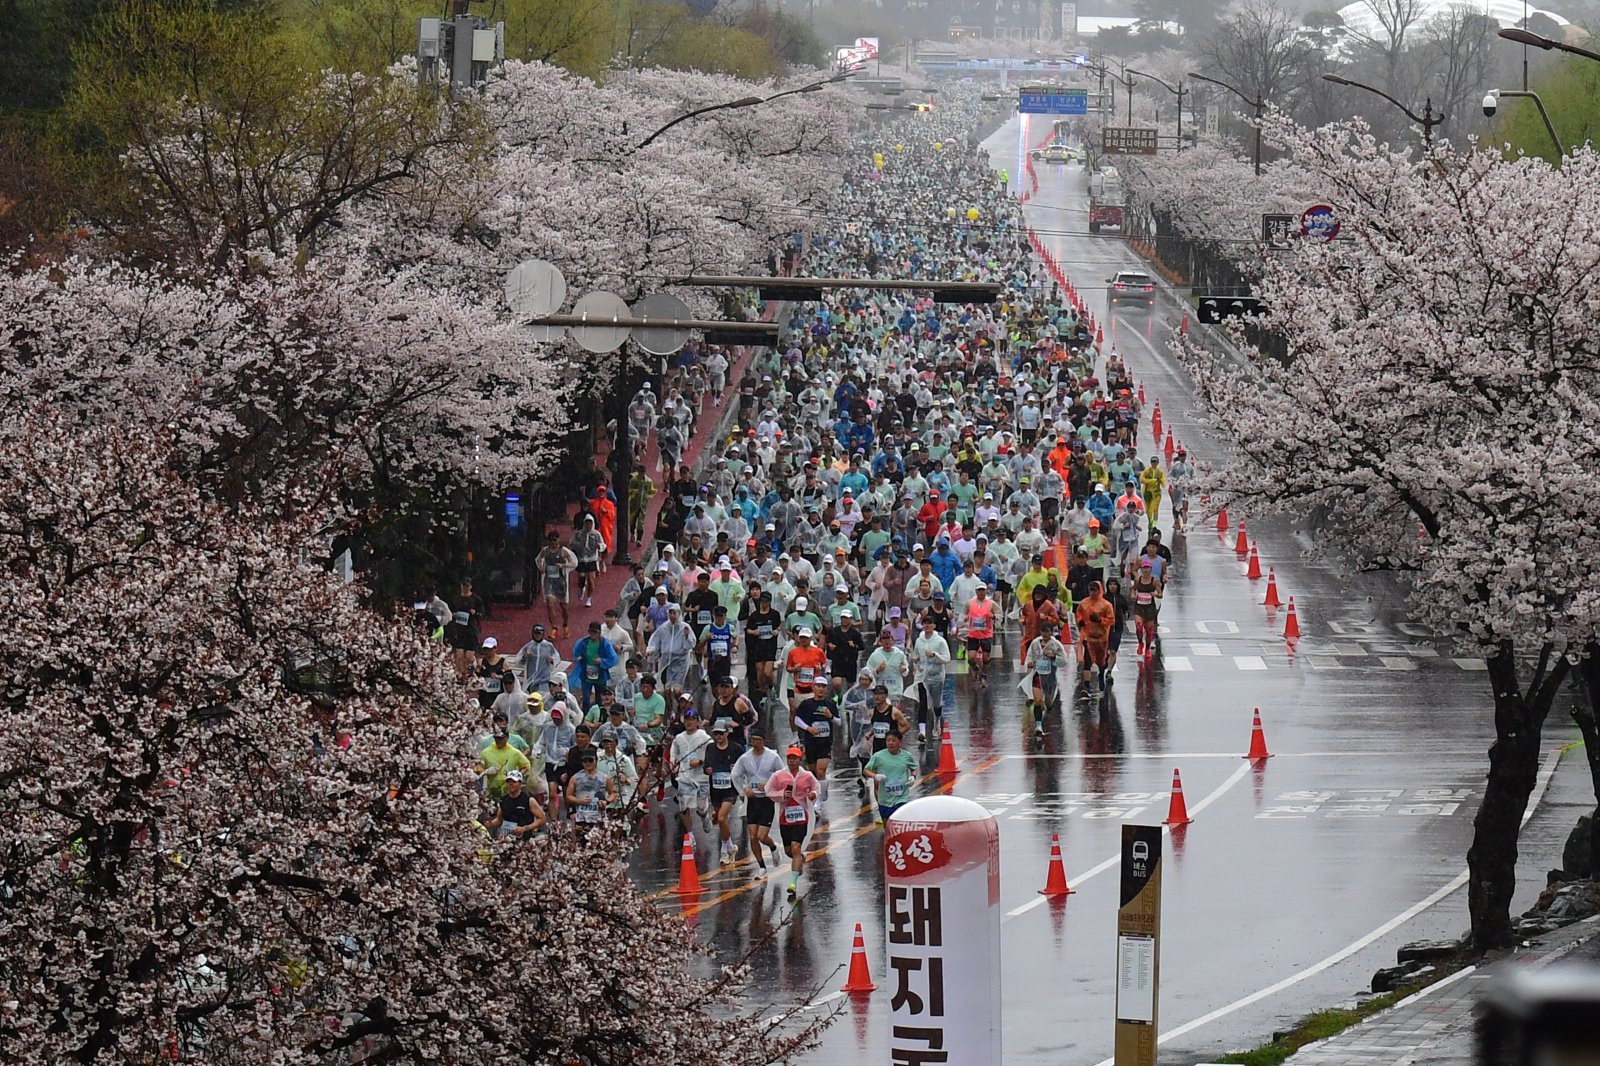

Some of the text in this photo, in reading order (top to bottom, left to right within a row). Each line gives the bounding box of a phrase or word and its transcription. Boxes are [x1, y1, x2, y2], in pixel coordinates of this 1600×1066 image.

[1106, 130, 1155, 139] 경주월드리조트
[1106, 139, 1155, 148] 캘리포니아비치
[1133, 862, 1147, 870] 버스
[1132, 870, 1147, 878] BUS
